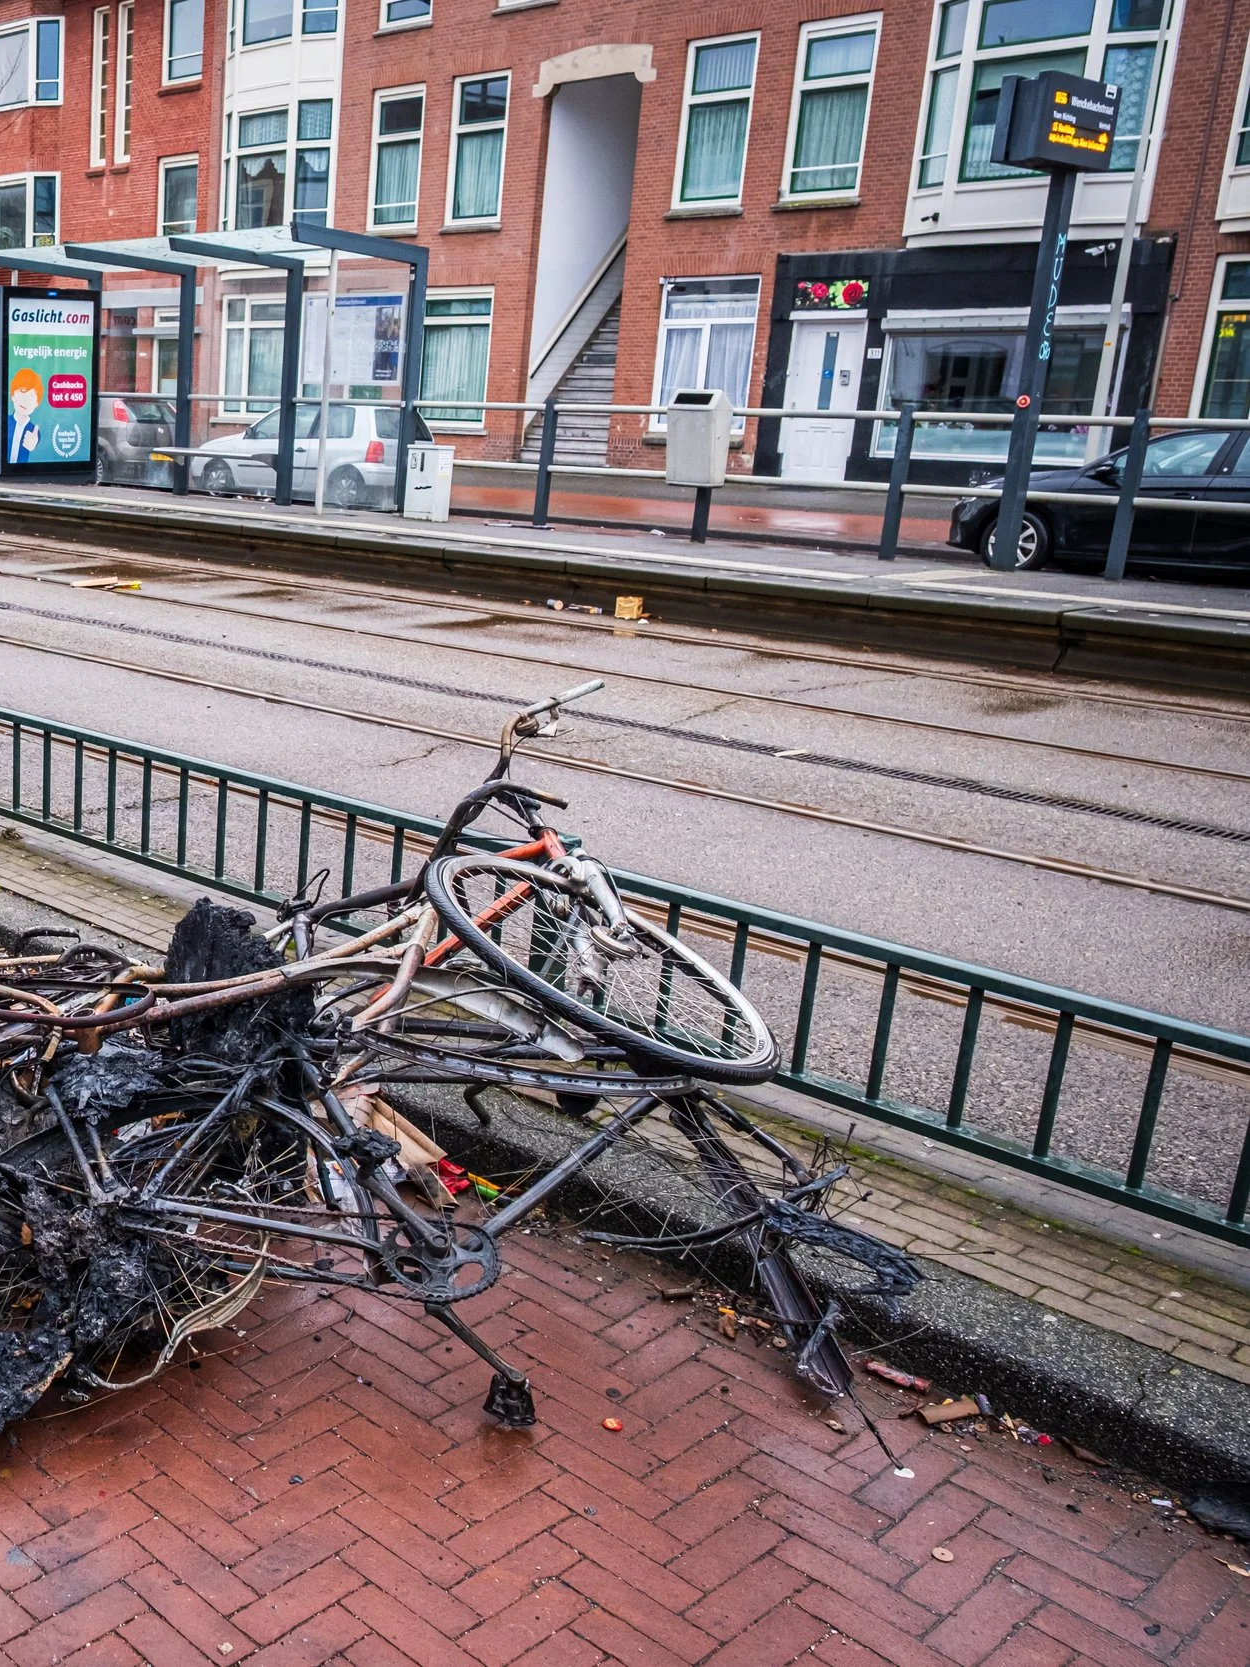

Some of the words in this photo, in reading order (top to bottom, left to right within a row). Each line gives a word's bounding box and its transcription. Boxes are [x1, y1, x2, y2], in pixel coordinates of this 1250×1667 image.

[11, 308, 90, 324] Gaslicht.com
[13, 345, 53, 359] Vergelijk
[54, 347, 88, 360] energie
[52, 381, 84, 389] Cashbacks
[52, 393, 63, 401] tot
[70, 393, 84, 401] 450
